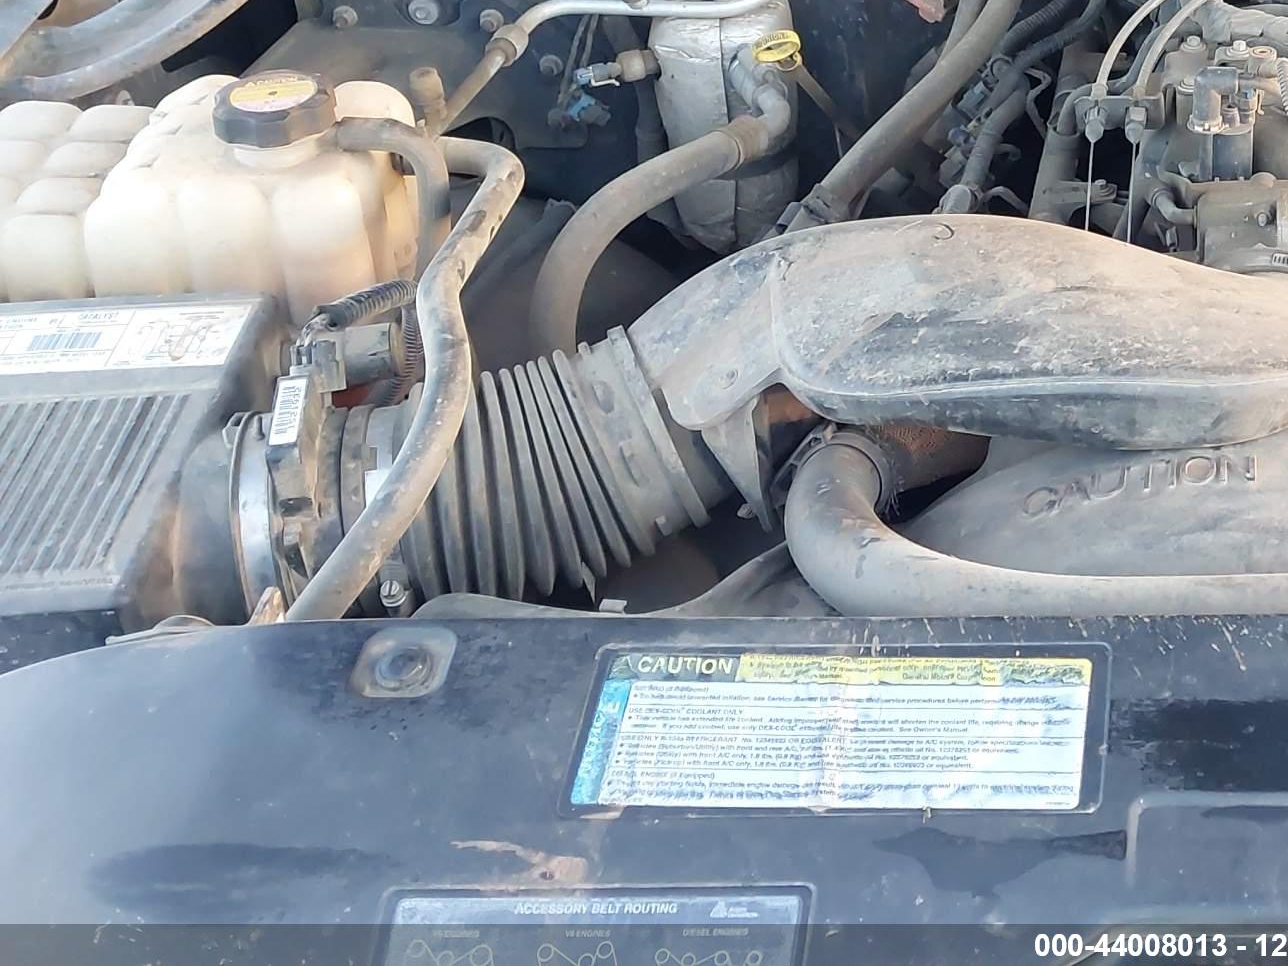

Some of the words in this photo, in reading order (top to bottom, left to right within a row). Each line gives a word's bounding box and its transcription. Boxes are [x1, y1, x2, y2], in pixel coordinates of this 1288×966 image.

[1022, 455, 1258, 516] CAUTION
[638, 656, 733, 674] CAUTION
[514, 903, 588, 914] ACCESSORY
[591, 903, 621, 914] BELT
[624, 903, 678, 914] ROUTING
